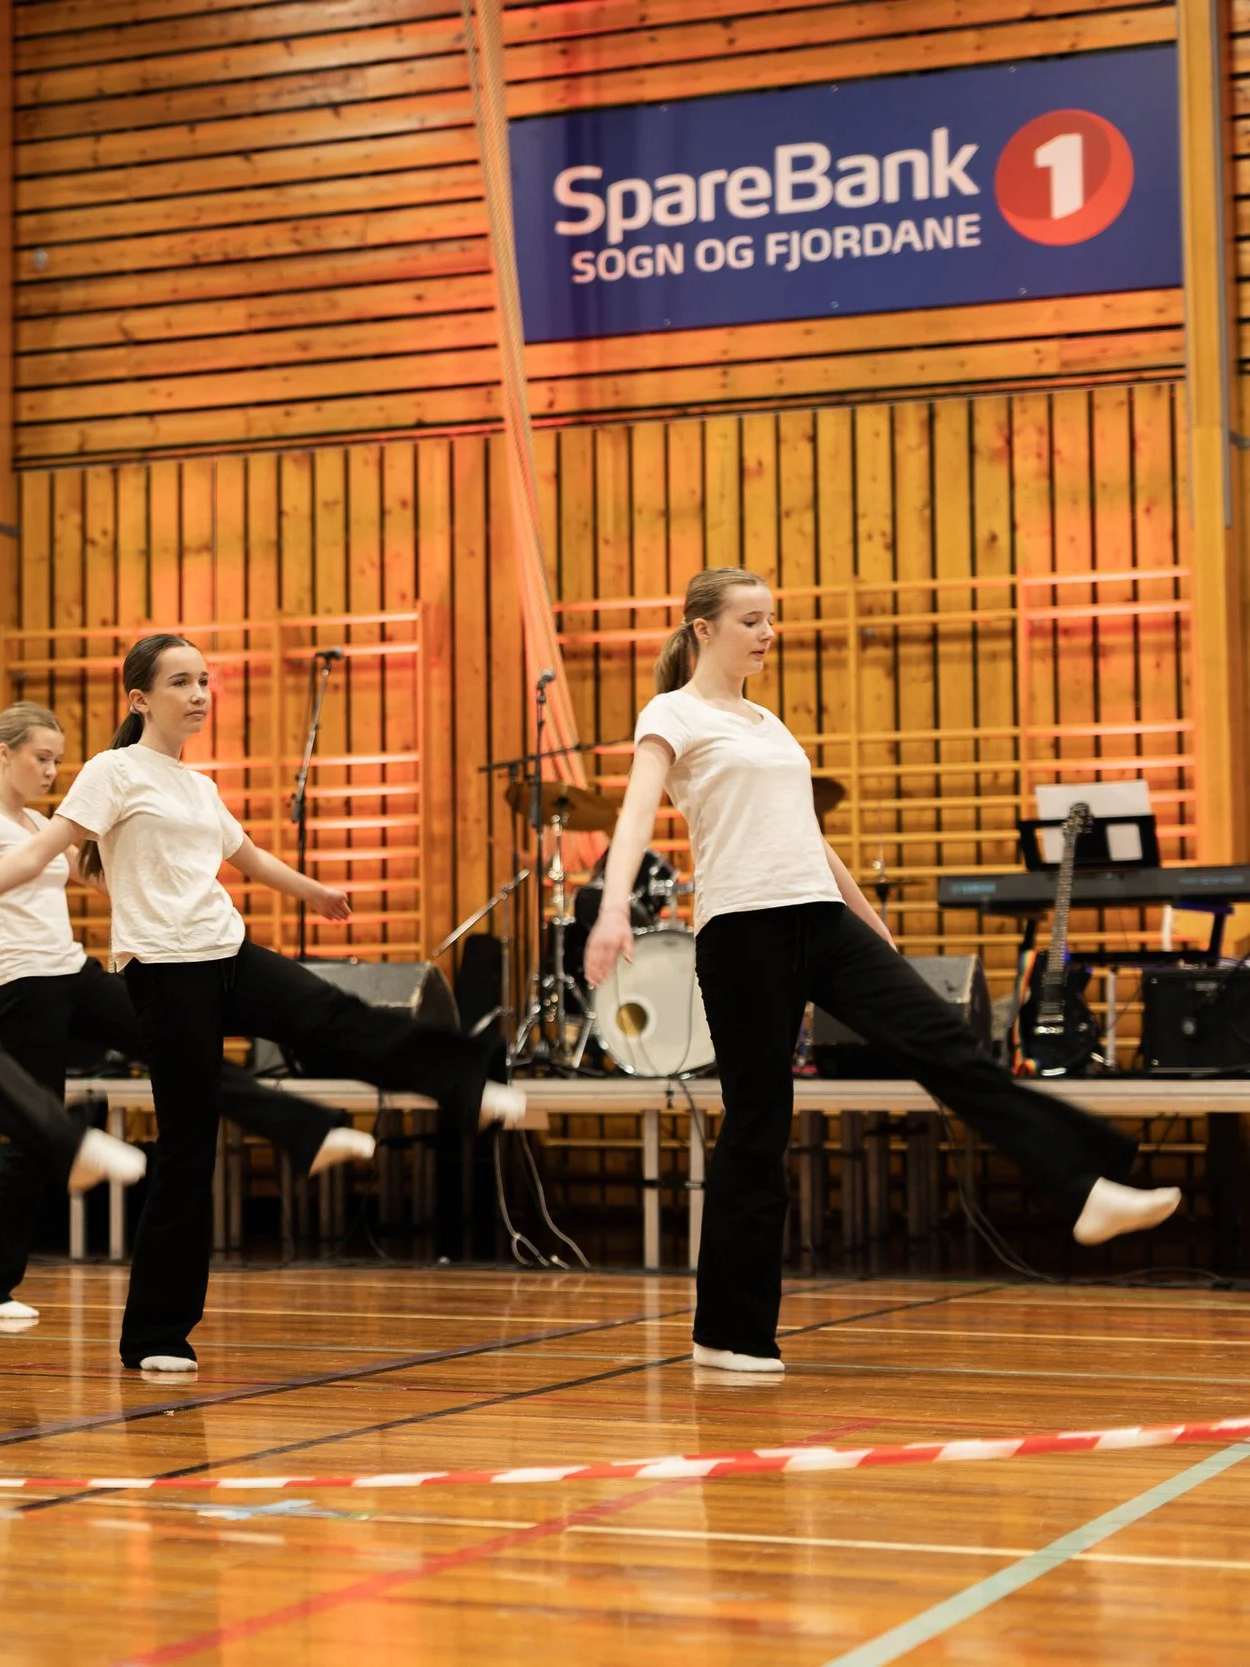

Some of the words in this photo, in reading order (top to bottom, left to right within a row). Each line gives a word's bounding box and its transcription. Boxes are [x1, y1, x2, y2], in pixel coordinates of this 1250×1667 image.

[552, 127, 980, 244] SpareBank
[1033, 132, 1085, 221] 1
[571, 242, 685, 284] SOGN
[694, 235, 753, 272] OG
[765, 213, 982, 271] FJORDANE
